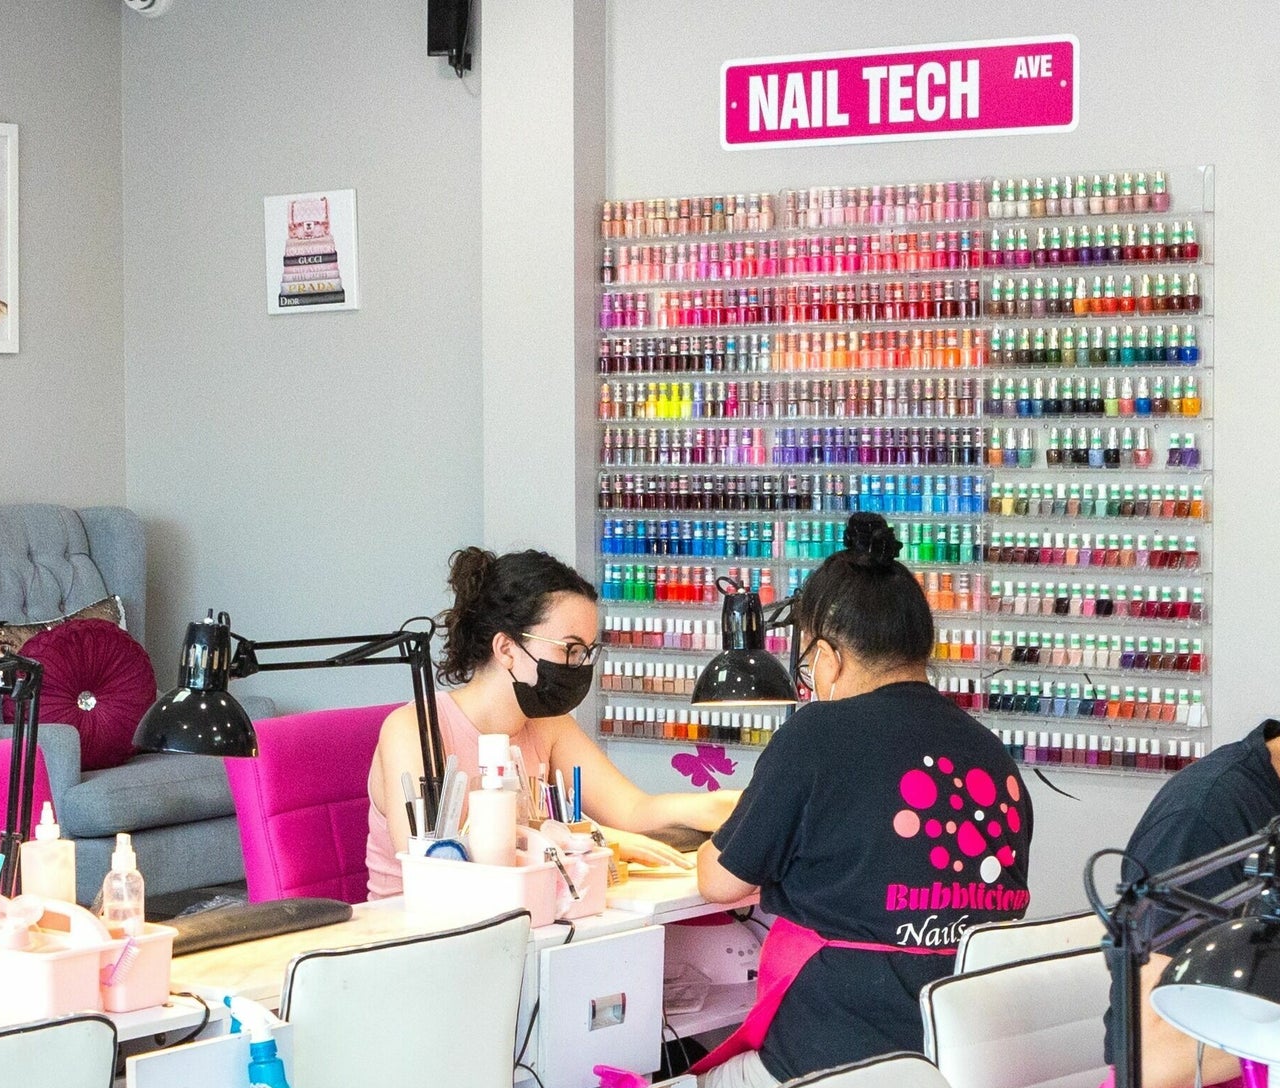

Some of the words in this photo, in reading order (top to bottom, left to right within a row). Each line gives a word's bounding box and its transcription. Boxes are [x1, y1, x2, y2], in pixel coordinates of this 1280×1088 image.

[748, 69, 850, 132] NAIL
[862, 59, 980, 125] TECH
[1013, 54, 1053, 79] AVE
[298, 255, 323, 265] GUCCI
[288, 281, 337, 293] PRADA
